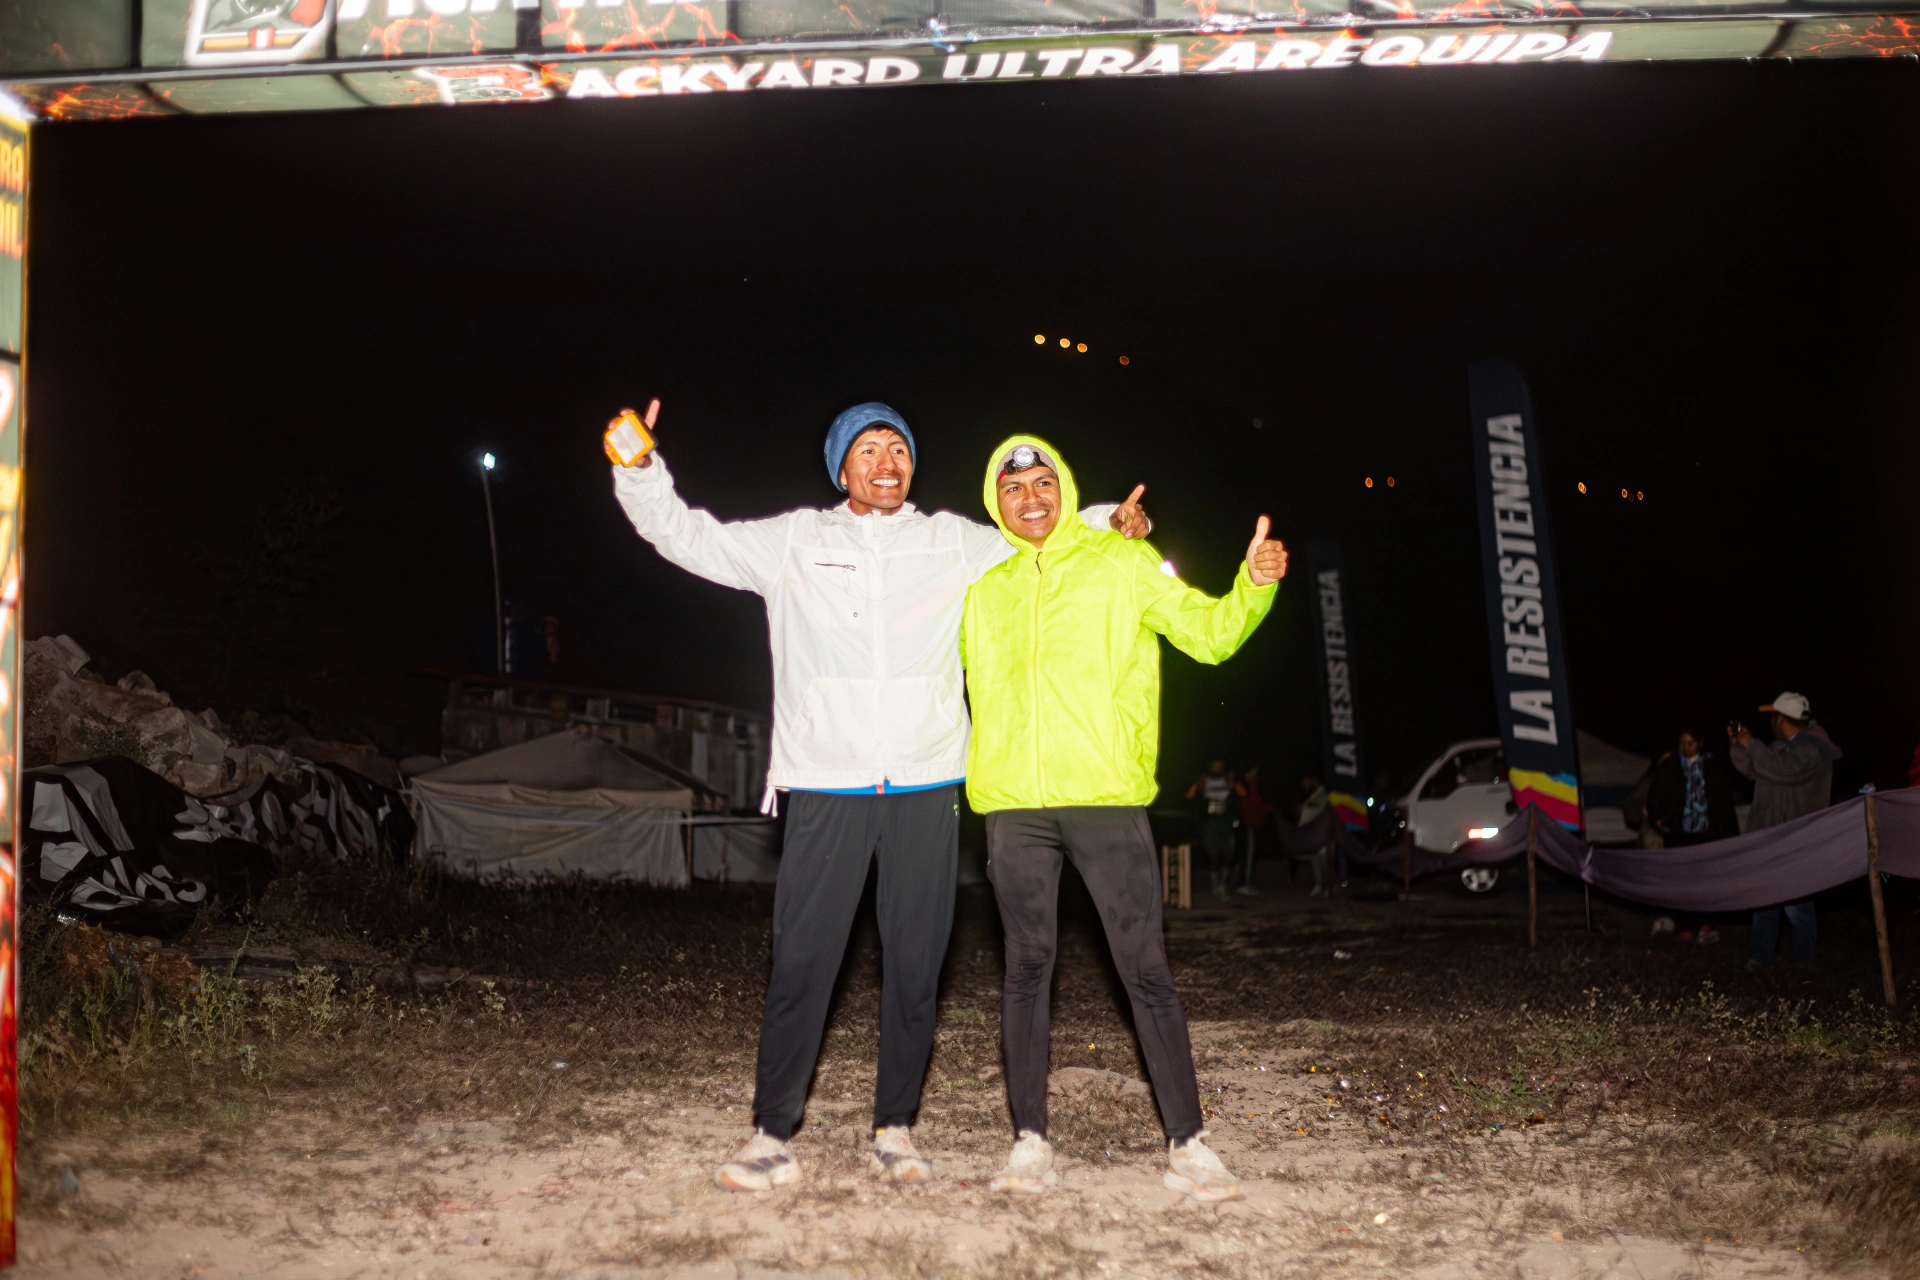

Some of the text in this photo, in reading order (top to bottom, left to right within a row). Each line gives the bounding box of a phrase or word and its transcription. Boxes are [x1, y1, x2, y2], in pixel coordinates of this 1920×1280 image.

[942, 43, 1181, 79] ULTRA
[1197, 30, 1614, 73] AREQUIPA
[1317, 570, 1358, 777] LA RESISTENCIA
[1487, 413, 1558, 745] LA RESISTENCIA
